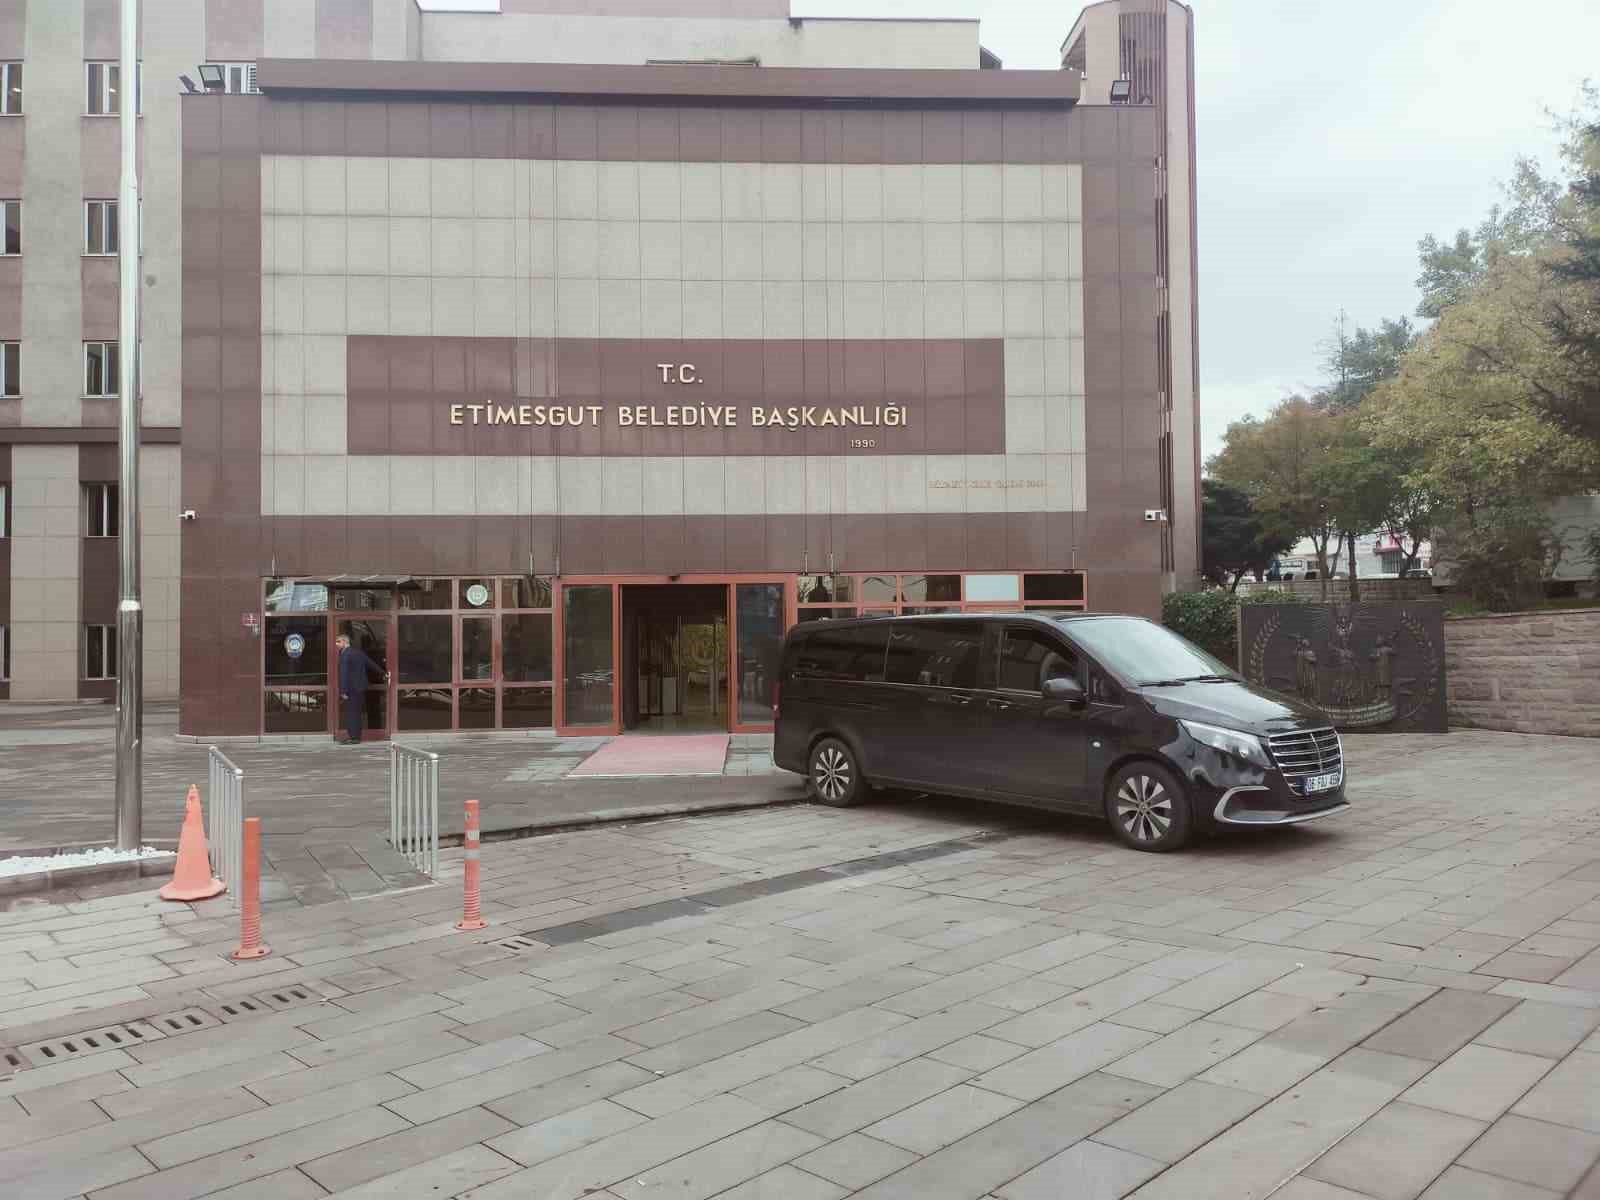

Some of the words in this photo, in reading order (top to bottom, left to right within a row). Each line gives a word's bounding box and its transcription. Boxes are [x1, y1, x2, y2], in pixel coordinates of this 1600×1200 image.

[657, 363, 703, 383] T.C.
[450, 399, 604, 426] ETİMESGUT
[618, 401, 737, 426] BELEDİYE
[751, 402, 907, 431] BAŞKANLIĞI
[851, 439, 876, 448] 1990
